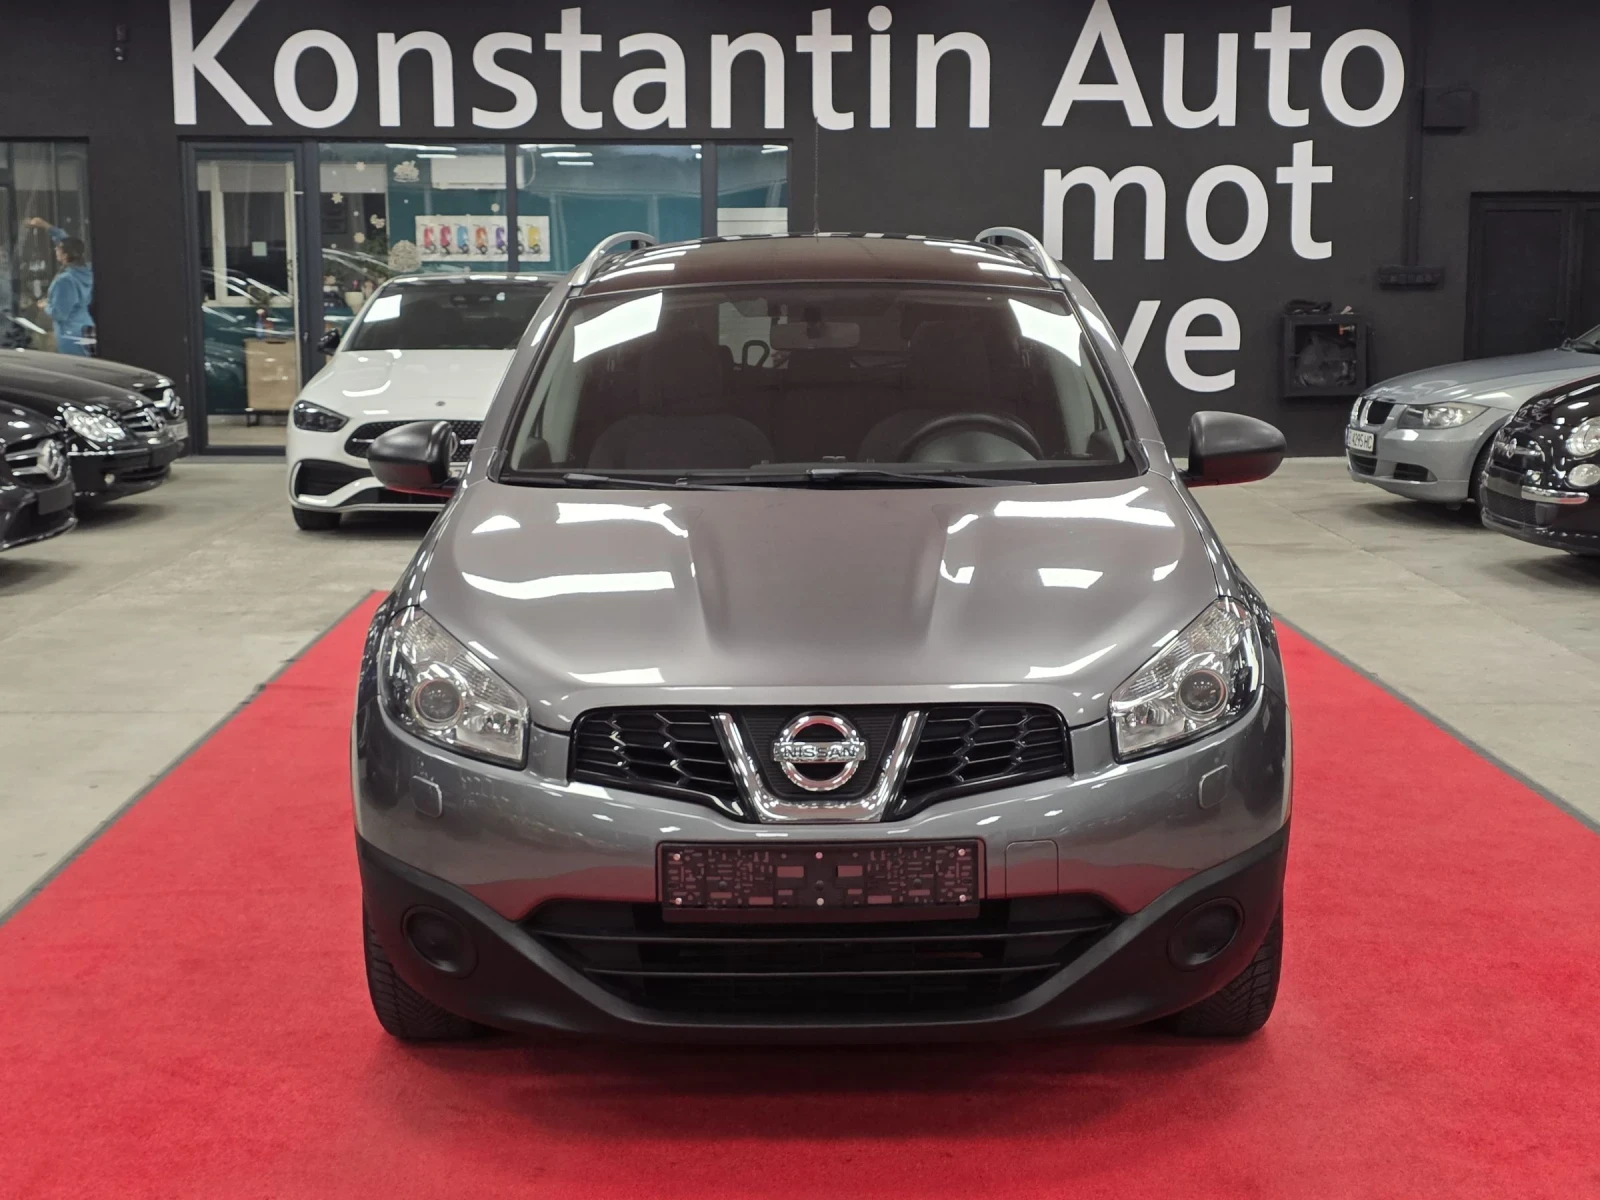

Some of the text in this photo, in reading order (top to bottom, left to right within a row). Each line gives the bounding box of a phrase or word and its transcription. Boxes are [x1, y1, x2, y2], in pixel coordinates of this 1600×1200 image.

[169, 0, 1405, 130] Konstantin Auto
[1042, 140, 1333, 262] mot
[784, 746, 856, 758] NISSAN
